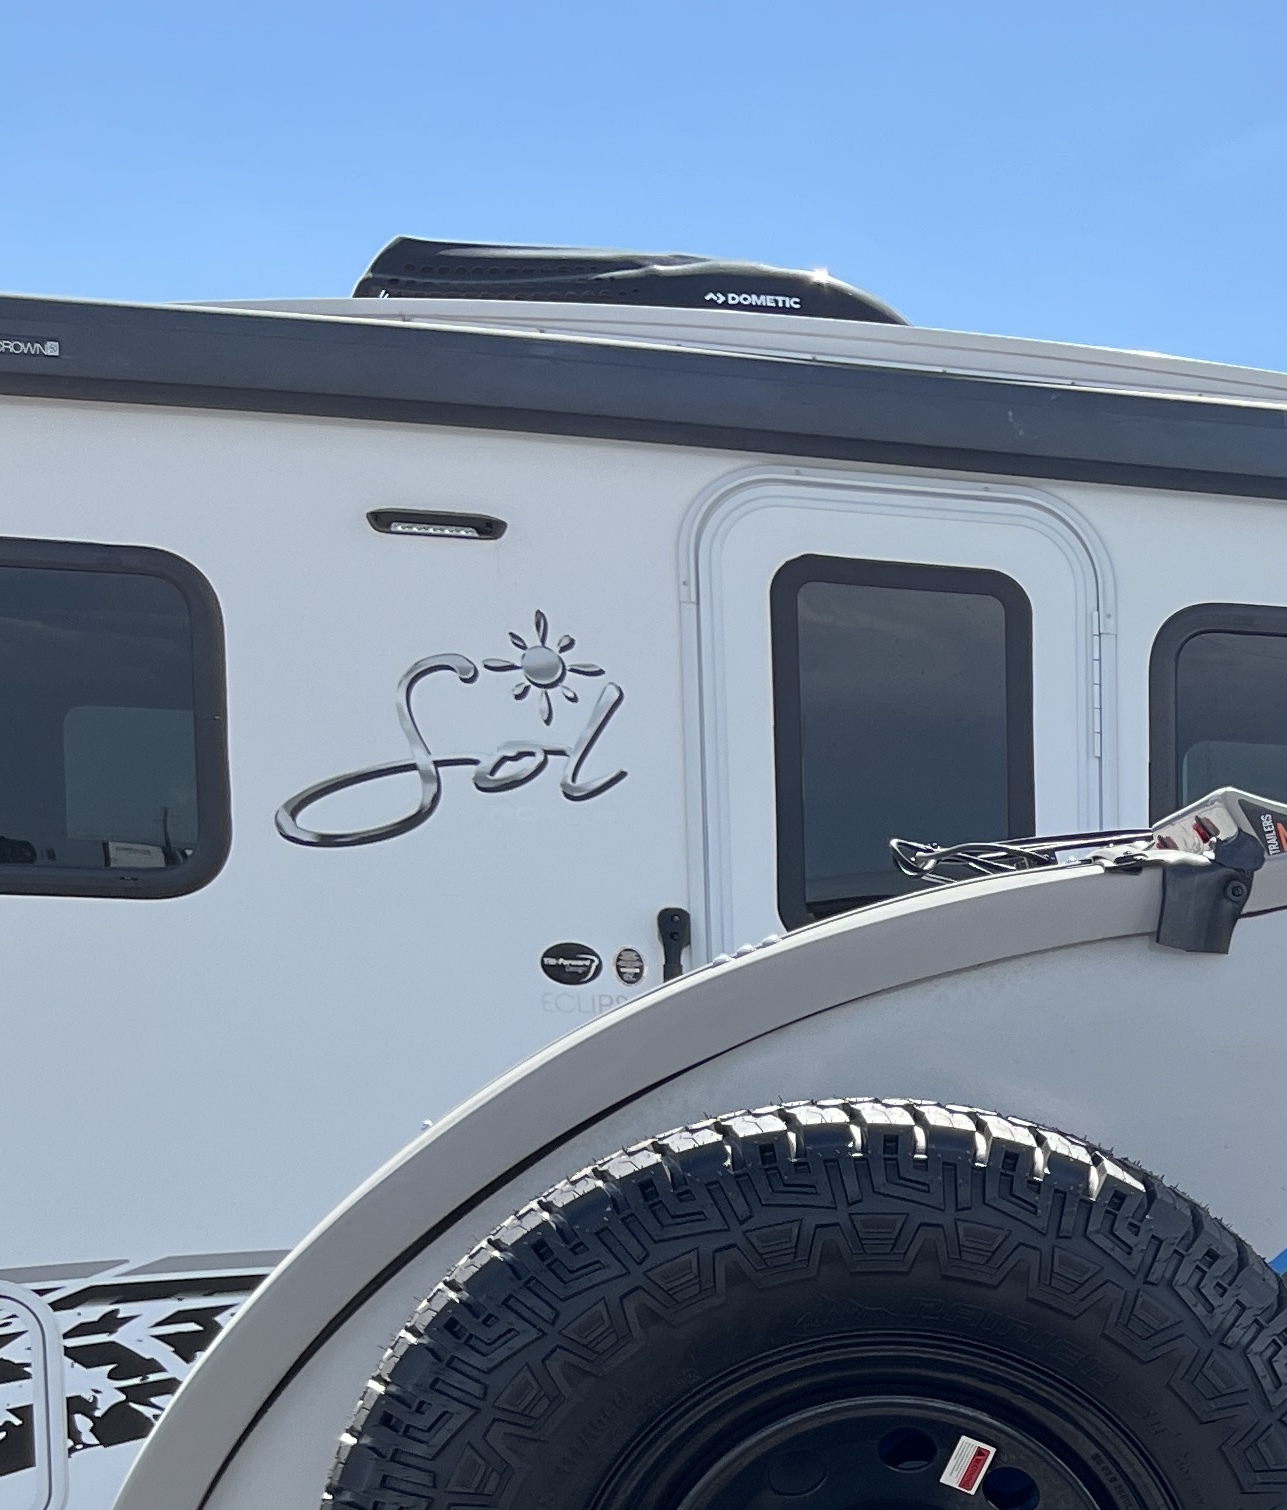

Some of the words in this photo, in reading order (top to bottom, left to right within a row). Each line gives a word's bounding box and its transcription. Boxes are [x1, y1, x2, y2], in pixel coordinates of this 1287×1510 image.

[728, 293, 801, 309] DOMETIC
[275, 653, 628, 848] Sol
[1261, 814, 1280, 855] TRAILERS
